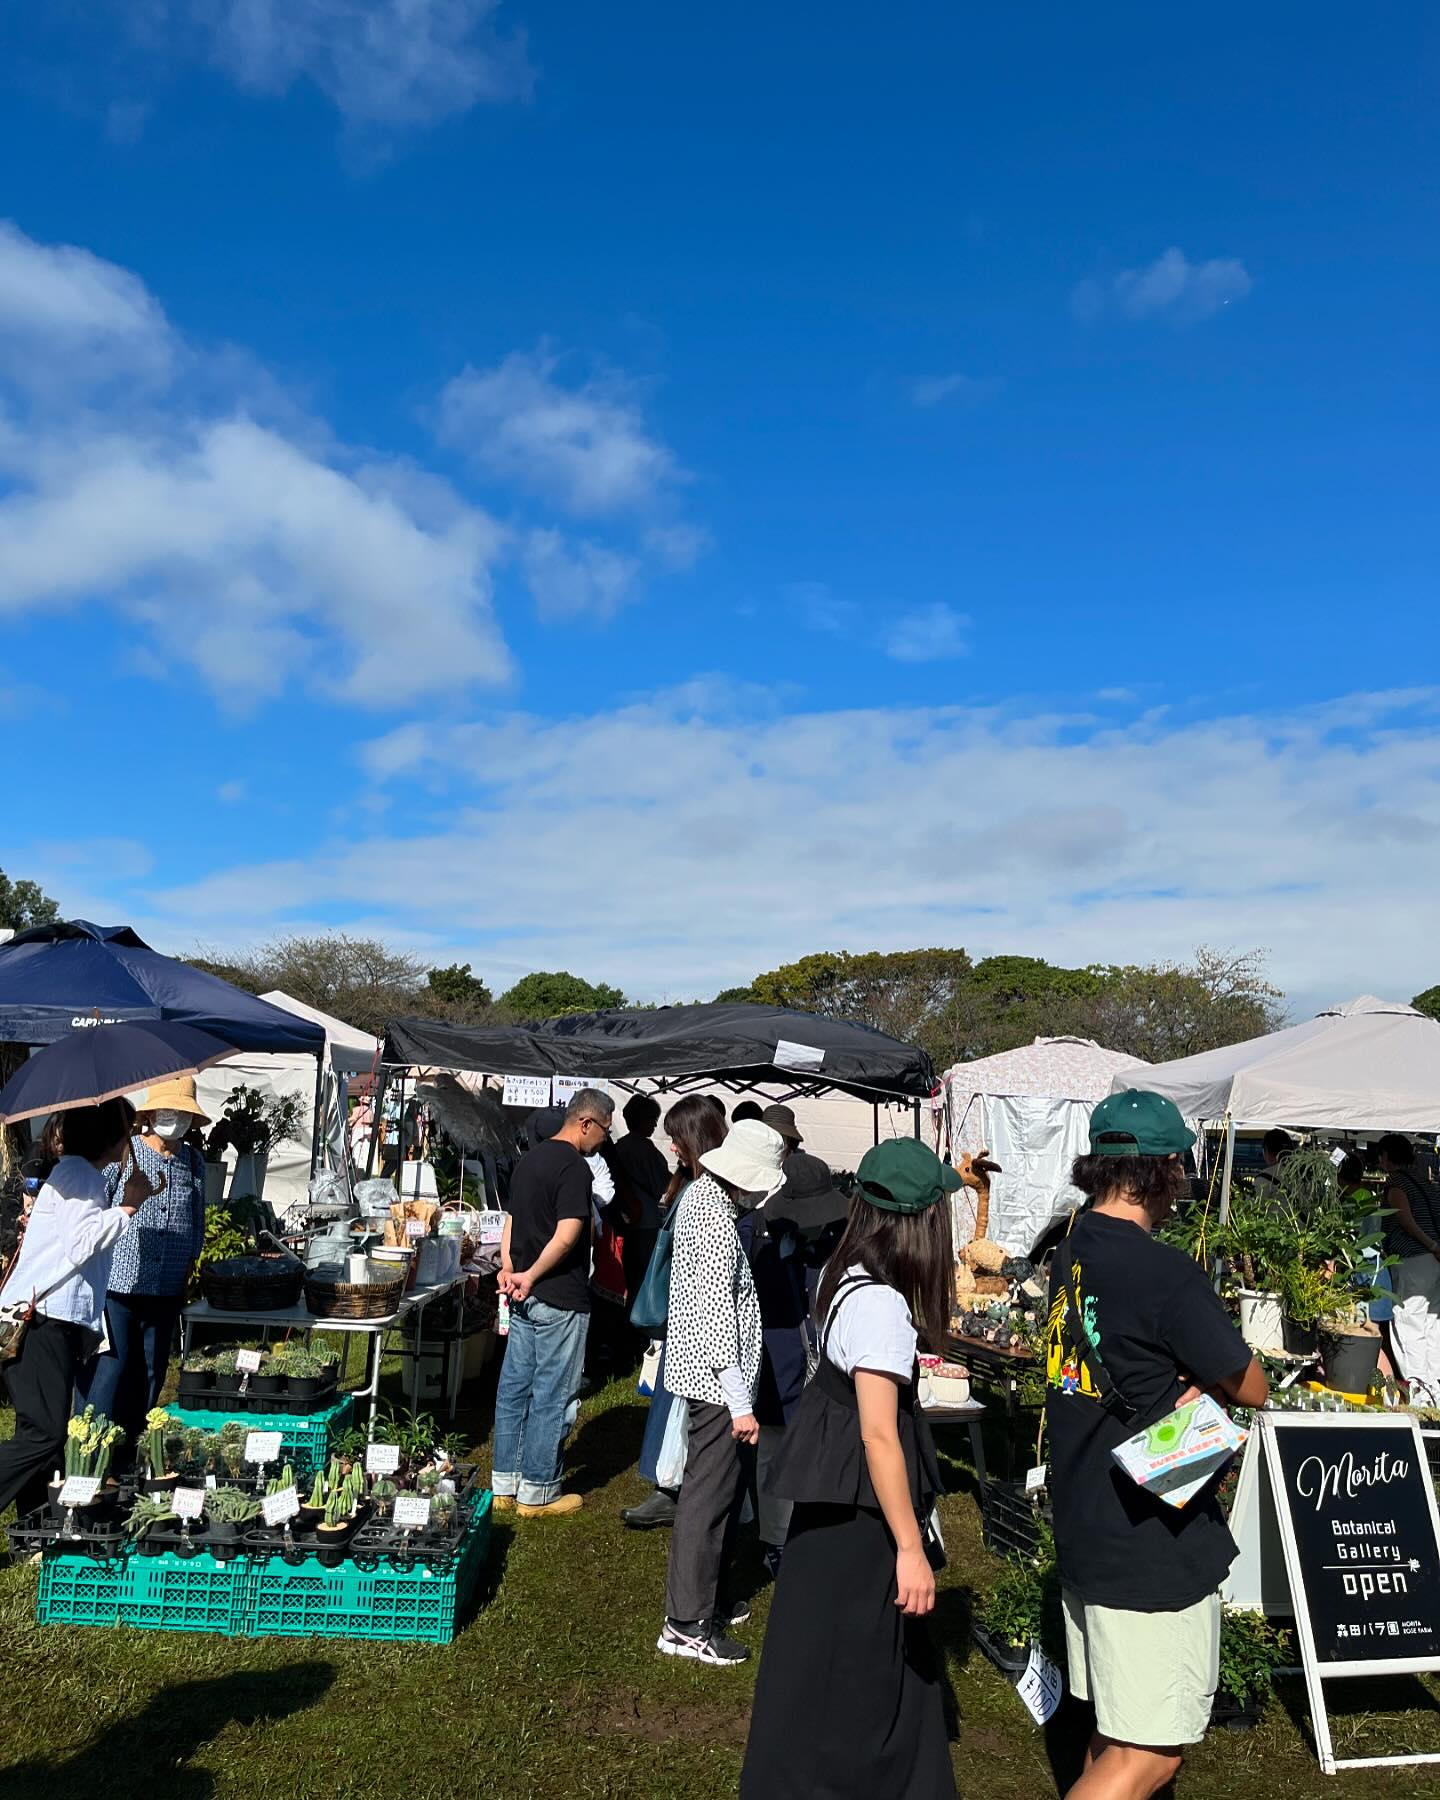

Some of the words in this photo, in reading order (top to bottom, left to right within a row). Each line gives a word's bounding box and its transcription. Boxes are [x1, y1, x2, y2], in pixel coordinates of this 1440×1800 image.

[1296, 1451, 1409, 1511] Morita
[1331, 1519, 1396, 1535] Botanical
[1336, 1543, 1401, 1561] Gallery
[1342, 1572, 1408, 1601] open
[1336, 1620, 1400, 1638] 森田バラ園
[1401, 1620, 1422, 1628] MORITA
[1023, 1676, 1052, 1715] ¥100
